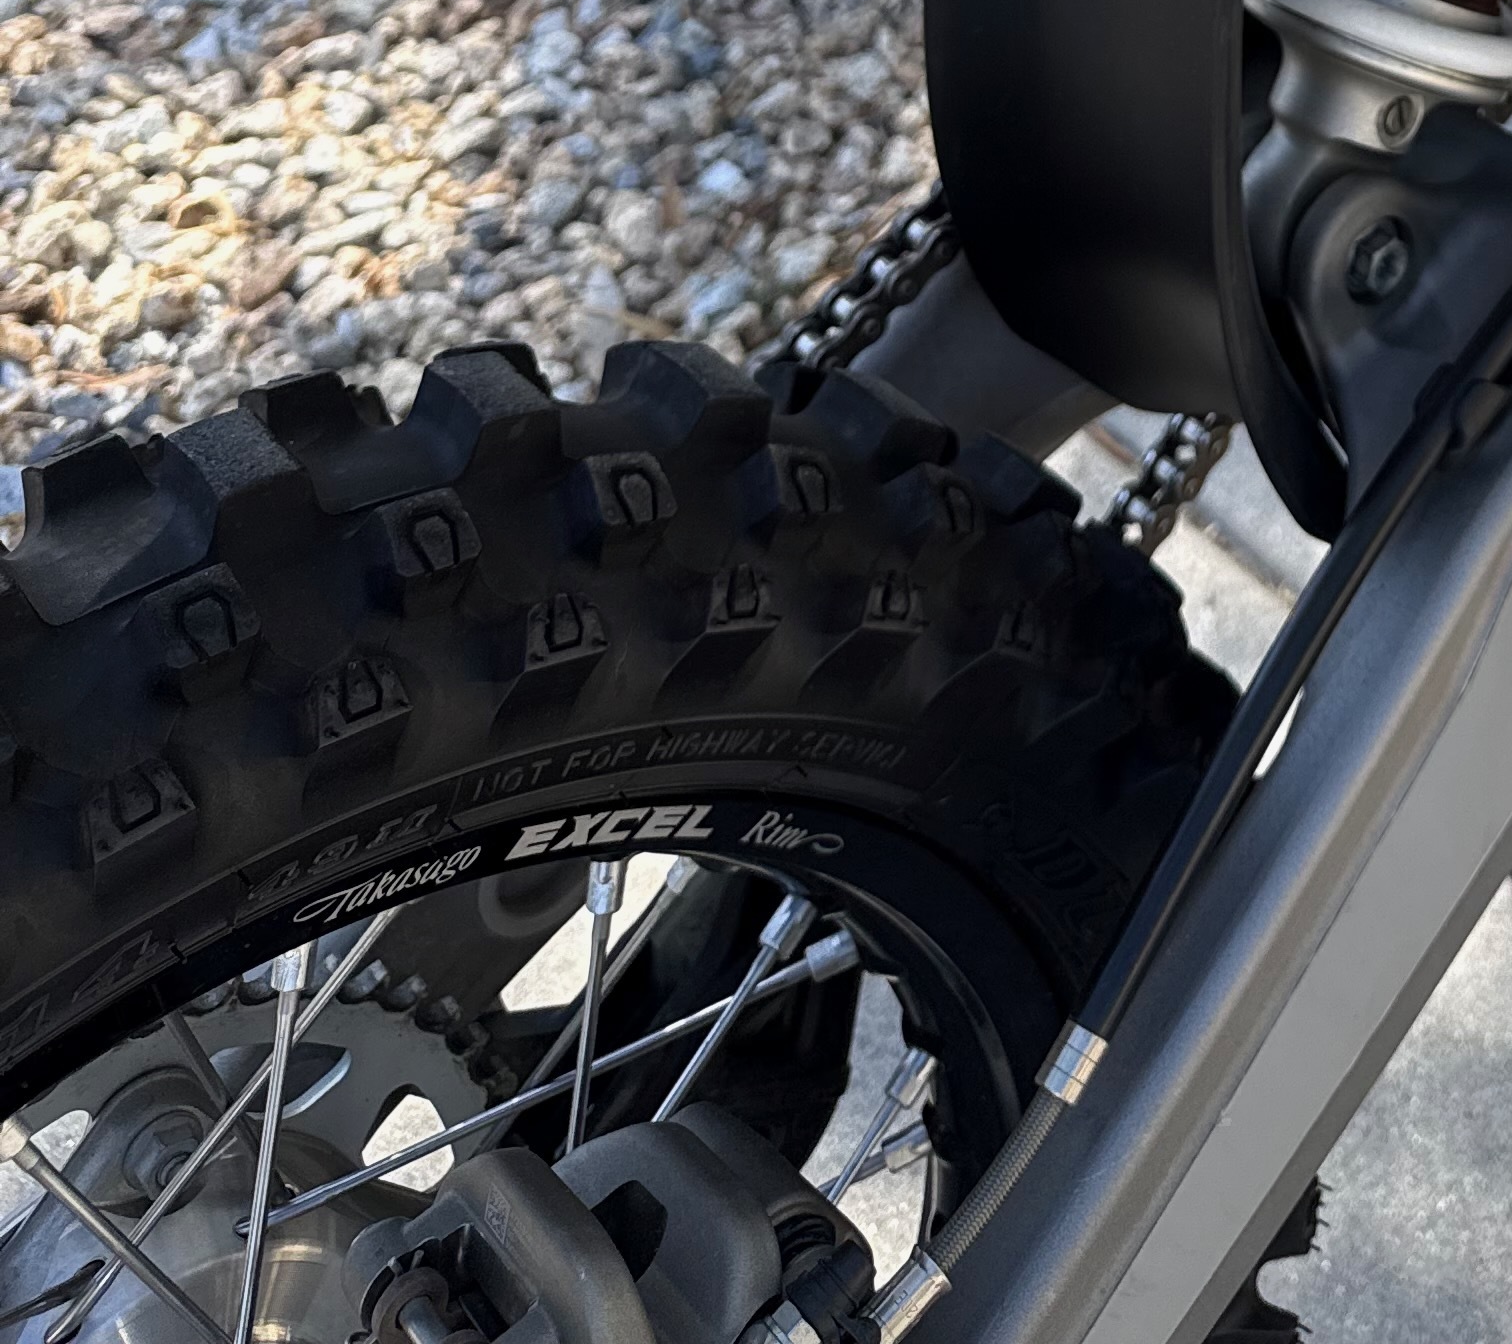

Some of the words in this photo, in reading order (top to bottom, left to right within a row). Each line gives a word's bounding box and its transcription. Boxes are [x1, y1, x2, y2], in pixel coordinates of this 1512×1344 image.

[472, 759, 553, 802] NOT
[644, 728, 790, 762] HIGHWAY
[293, 845, 482, 923] Takasago
[504, 804, 715, 861] EXCEL
[738, 810, 845, 854] Rim
